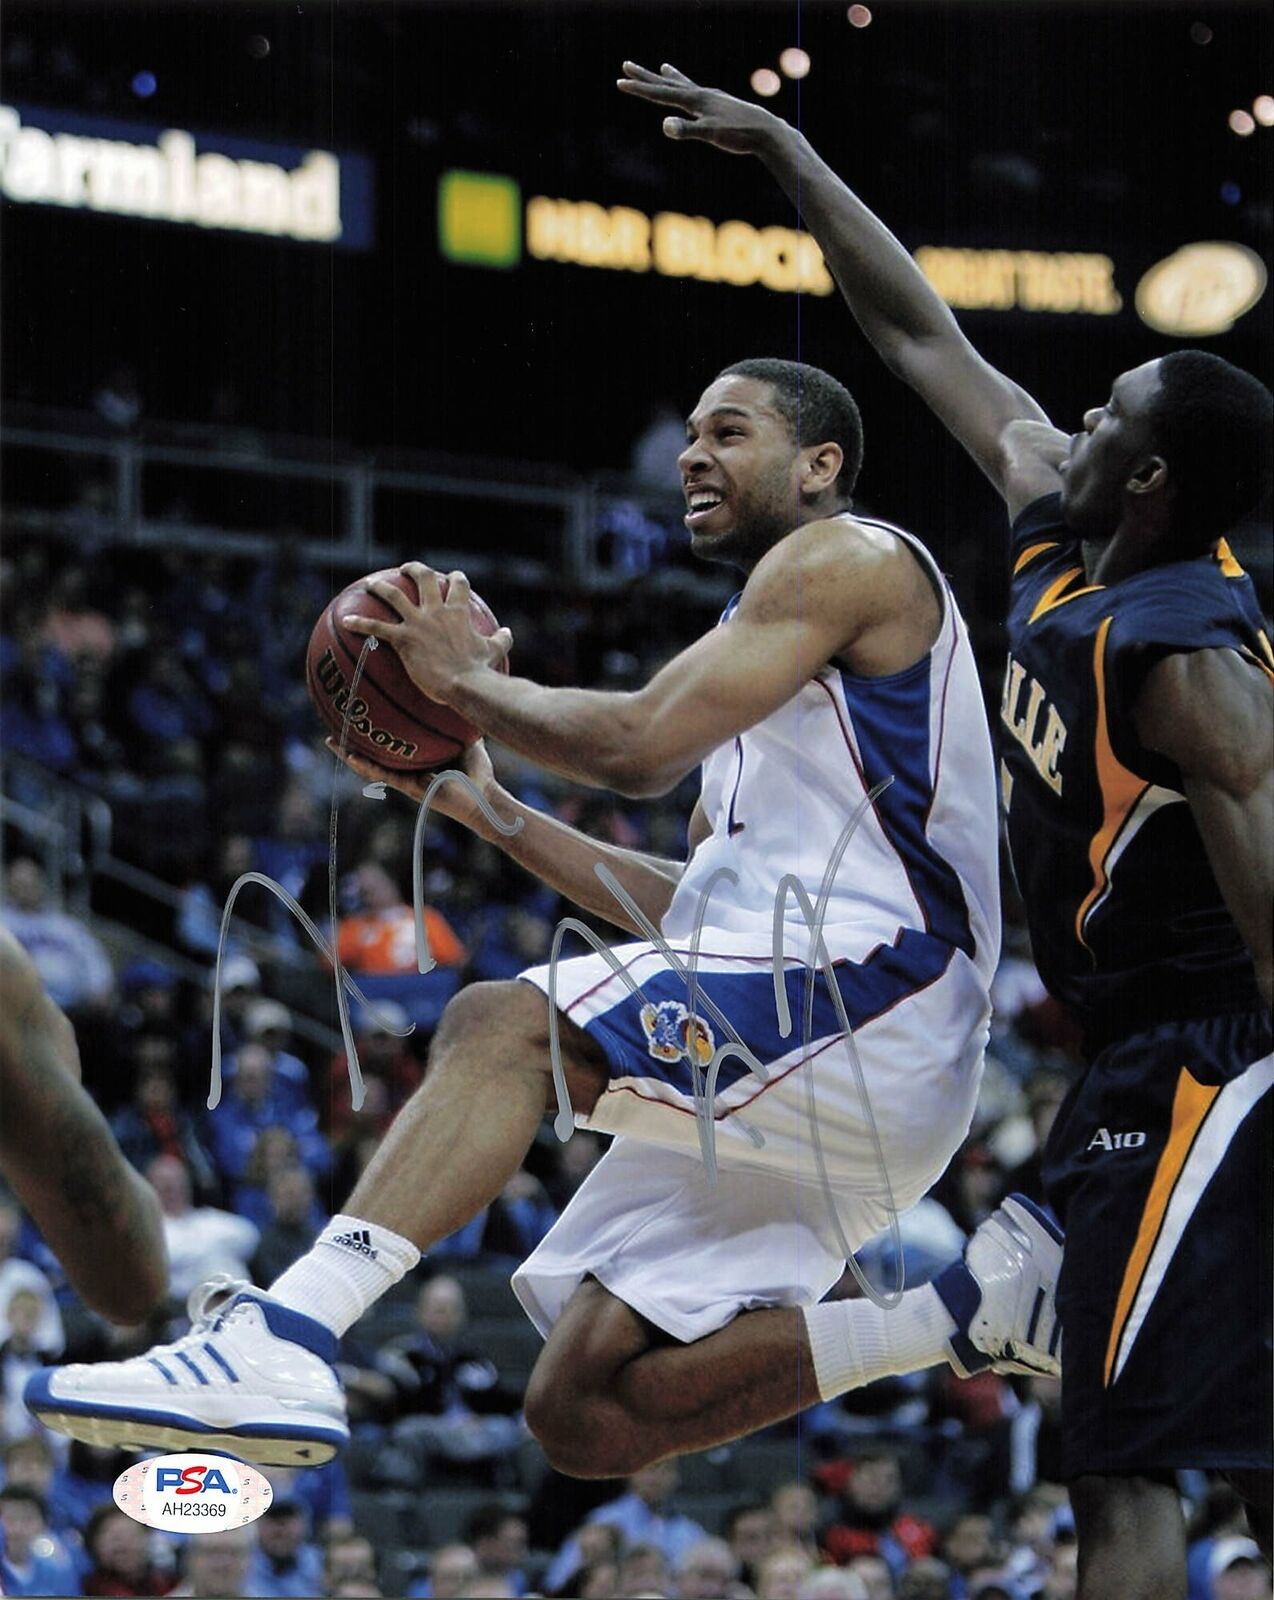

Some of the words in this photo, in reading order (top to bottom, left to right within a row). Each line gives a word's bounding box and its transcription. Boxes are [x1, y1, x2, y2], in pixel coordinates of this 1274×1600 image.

[317, 646, 417, 757] Wilson
[1001, 652, 1067, 797] LLE
[1087, 1127, 1147, 1151] A10
[333, 1235, 378, 1260] adidas
